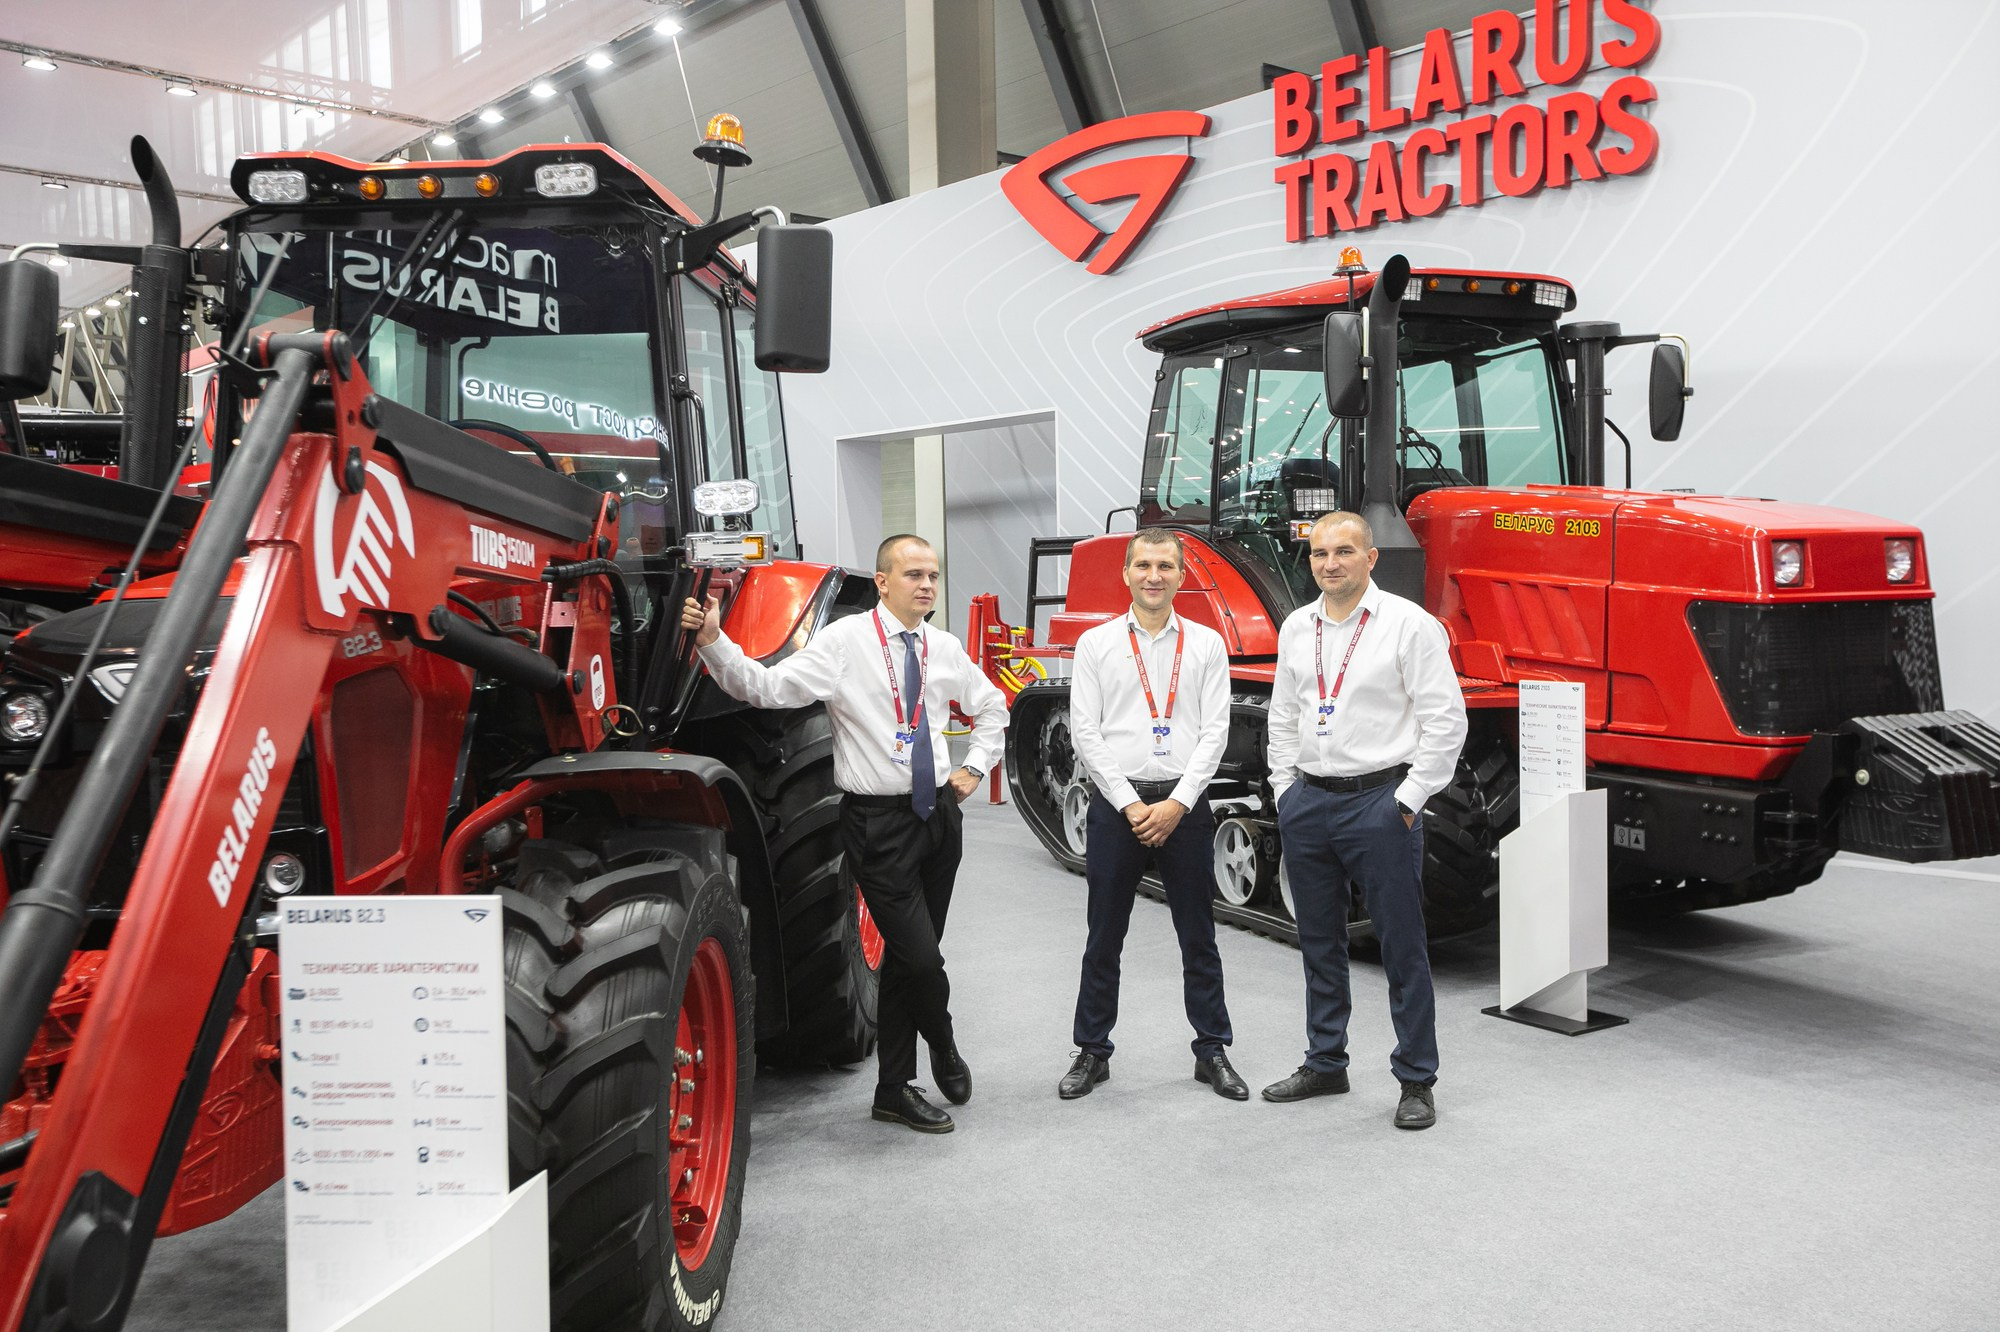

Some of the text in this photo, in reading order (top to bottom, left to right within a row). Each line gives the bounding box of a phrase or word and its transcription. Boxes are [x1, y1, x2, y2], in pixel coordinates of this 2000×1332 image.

[1273, 0, 1662, 158] BELARUS
[1274, 75, 1660, 244] TRACTORS
[1494, 512, 1600, 537] БЕЛАРУС 2103
[342, 630, 383, 658] 82.3
[207, 726, 277, 908] BELARUS
[287, 908, 387, 924] BELARUS 82.3
[302, 962, 480, 976] ТЕХНИЧЕСКИЕ ХАРАКТЕРИСТИКИ
